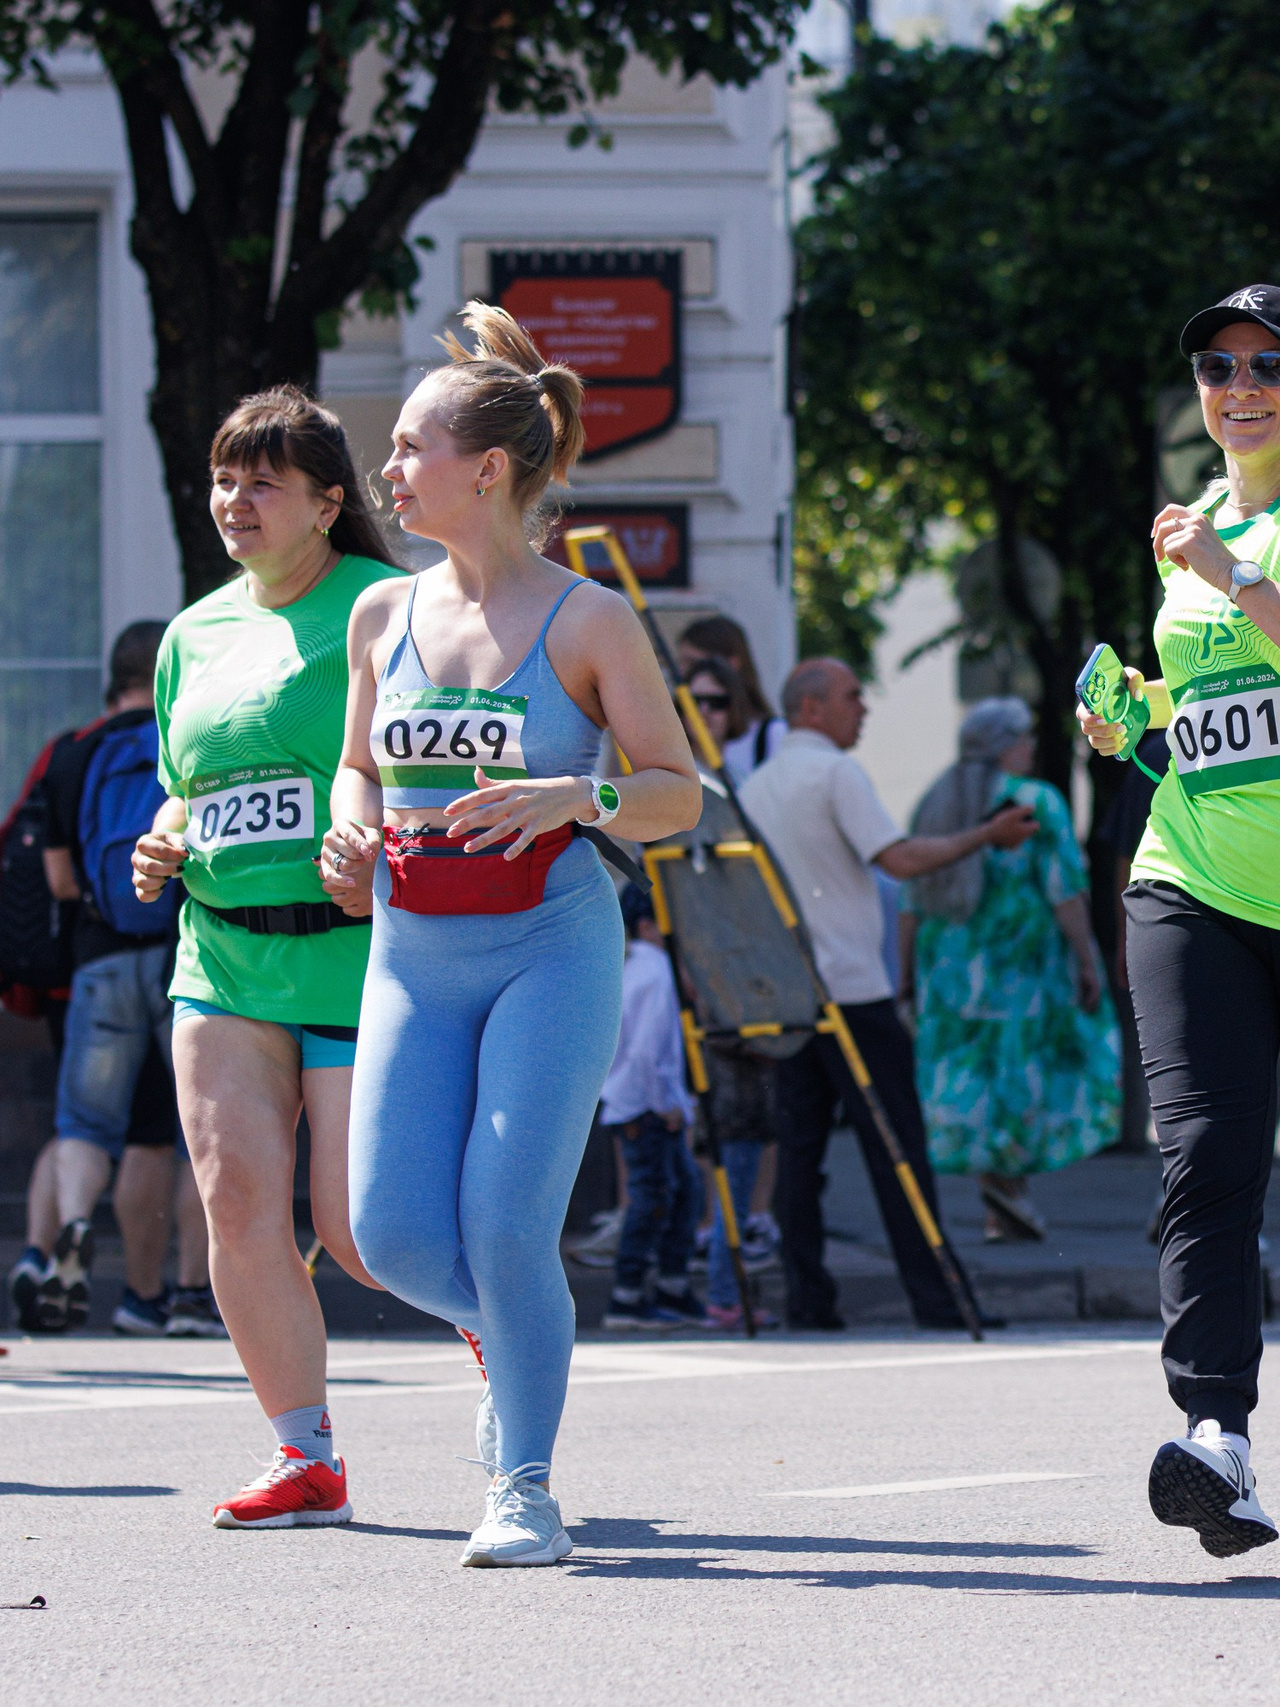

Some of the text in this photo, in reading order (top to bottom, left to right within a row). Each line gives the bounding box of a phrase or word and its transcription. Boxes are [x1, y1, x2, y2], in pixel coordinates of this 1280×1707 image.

[1235, 673, 1276, 686] 01.06.2024
[469, 696, 511, 709] 01.06.2024
[384, 718, 507, 760] 0269
[1173, 698, 1279, 762] 0601
[199, 787, 302, 843] 0235
